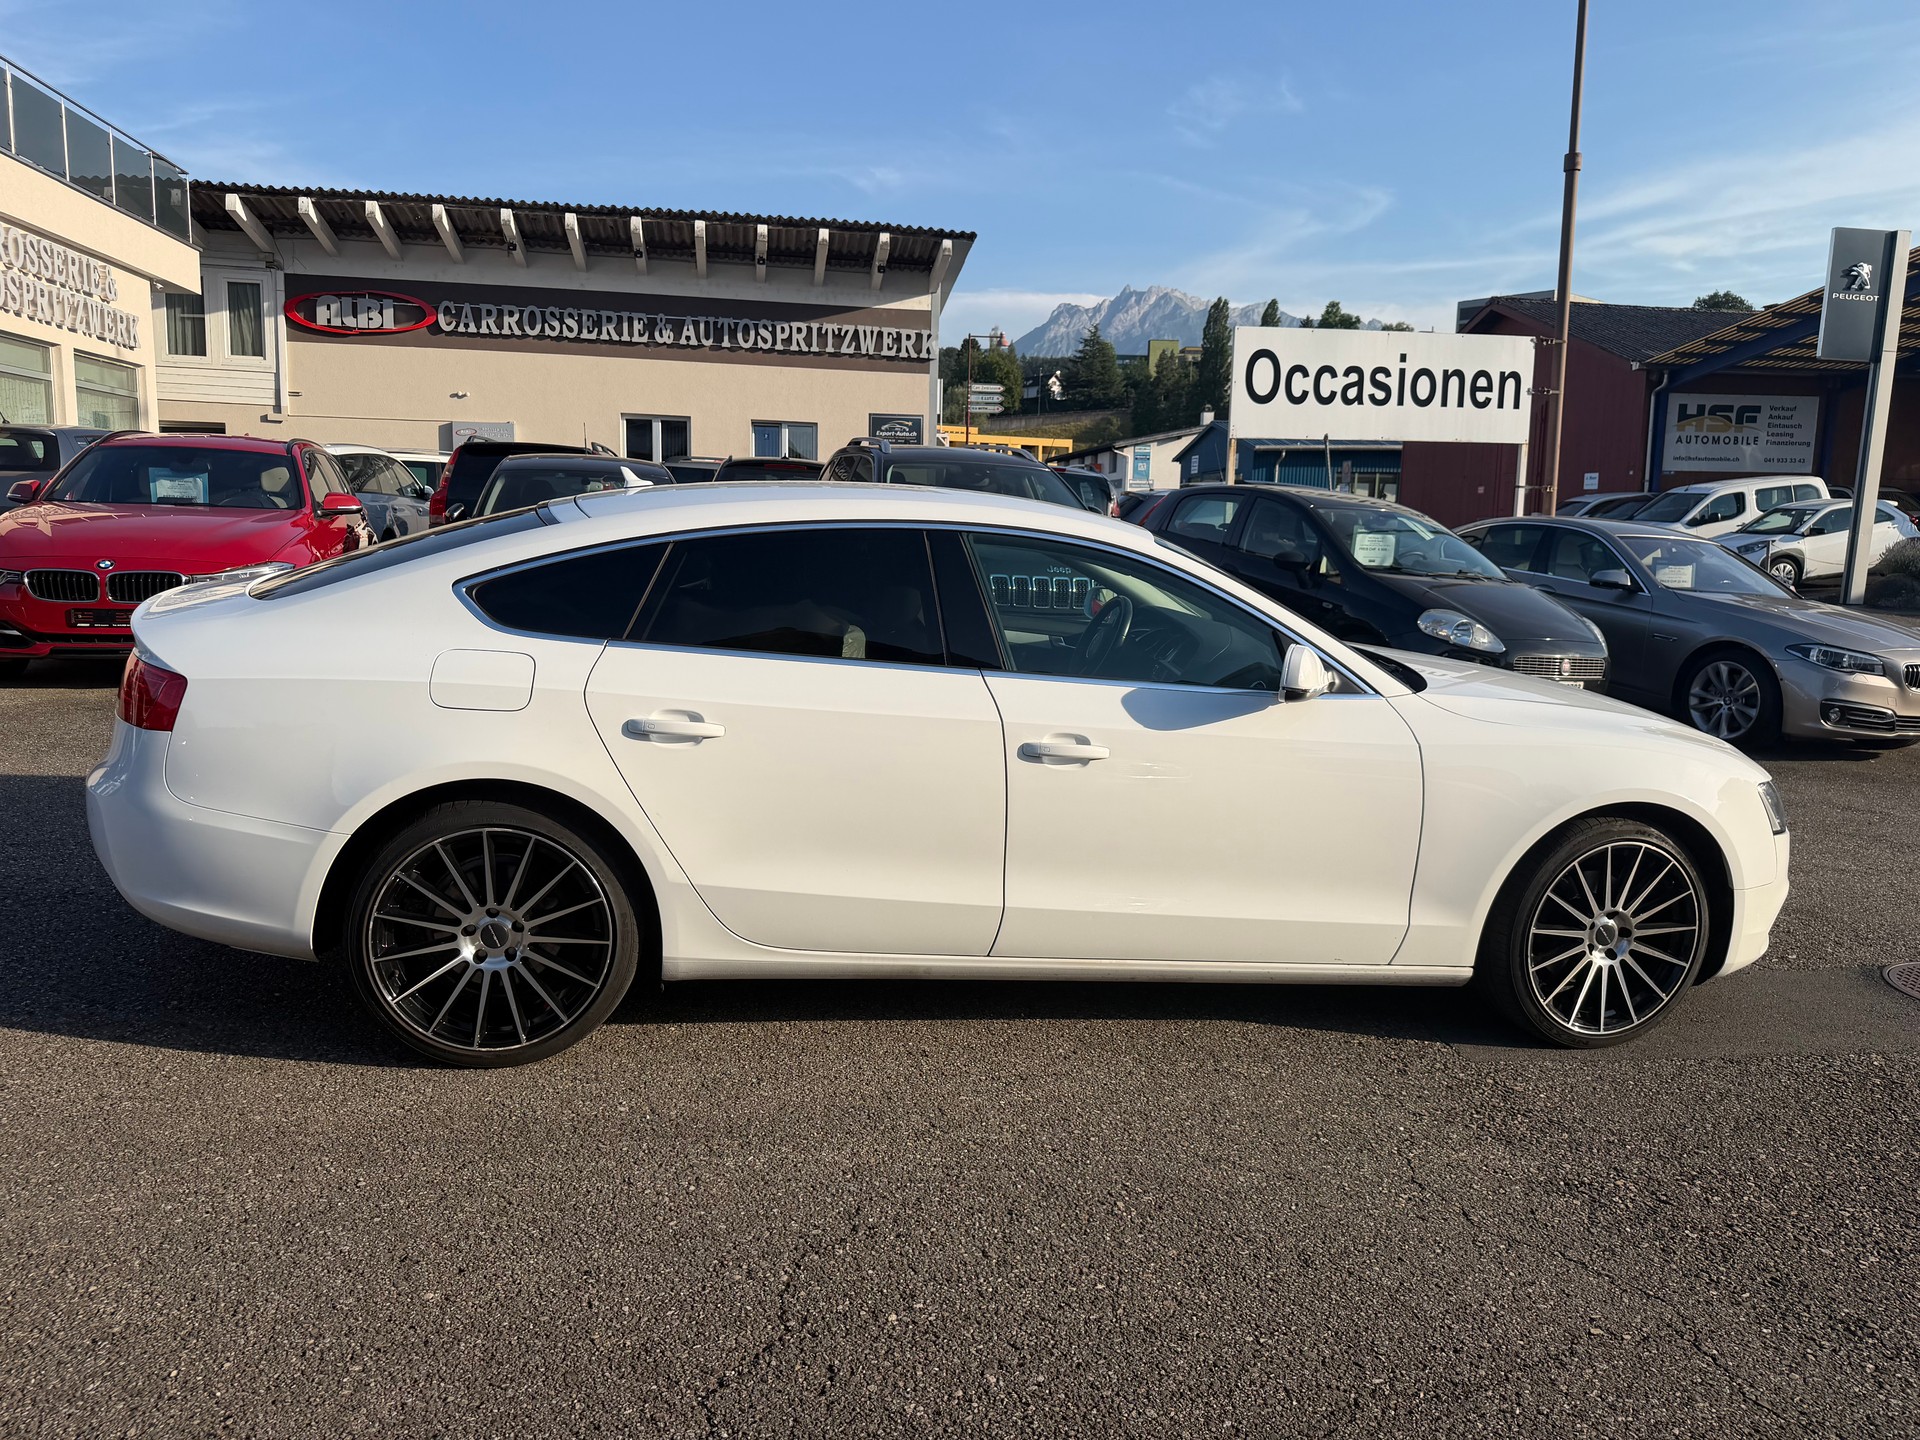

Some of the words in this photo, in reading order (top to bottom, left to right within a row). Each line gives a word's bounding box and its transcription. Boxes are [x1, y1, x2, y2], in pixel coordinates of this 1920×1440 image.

[105, 264, 118, 302] &
[1832, 292, 1880, 302] PEUGEOT
[315, 294, 395, 331] ALBI
[437, 299, 649, 344] CARROSSERIE
[654, 314, 674, 345] &
[679, 315, 938, 361] AUTOSPRITZWERK
[1245, 347, 1522, 410] Occasionen
[1769, 404, 1797, 412] Verkauf
[1676, 403, 1762, 433] HSF
[1768, 413, 1794, 421] Ankauf
[1767, 422, 1803, 430] Eintausch
[1766, 430, 1794, 439] Leasing
[1675, 435, 1759, 446] AUTOMOBILE
[1765, 439, 1811, 448] Finanzierung
[1046, 565, 1071, 574] Jeep
